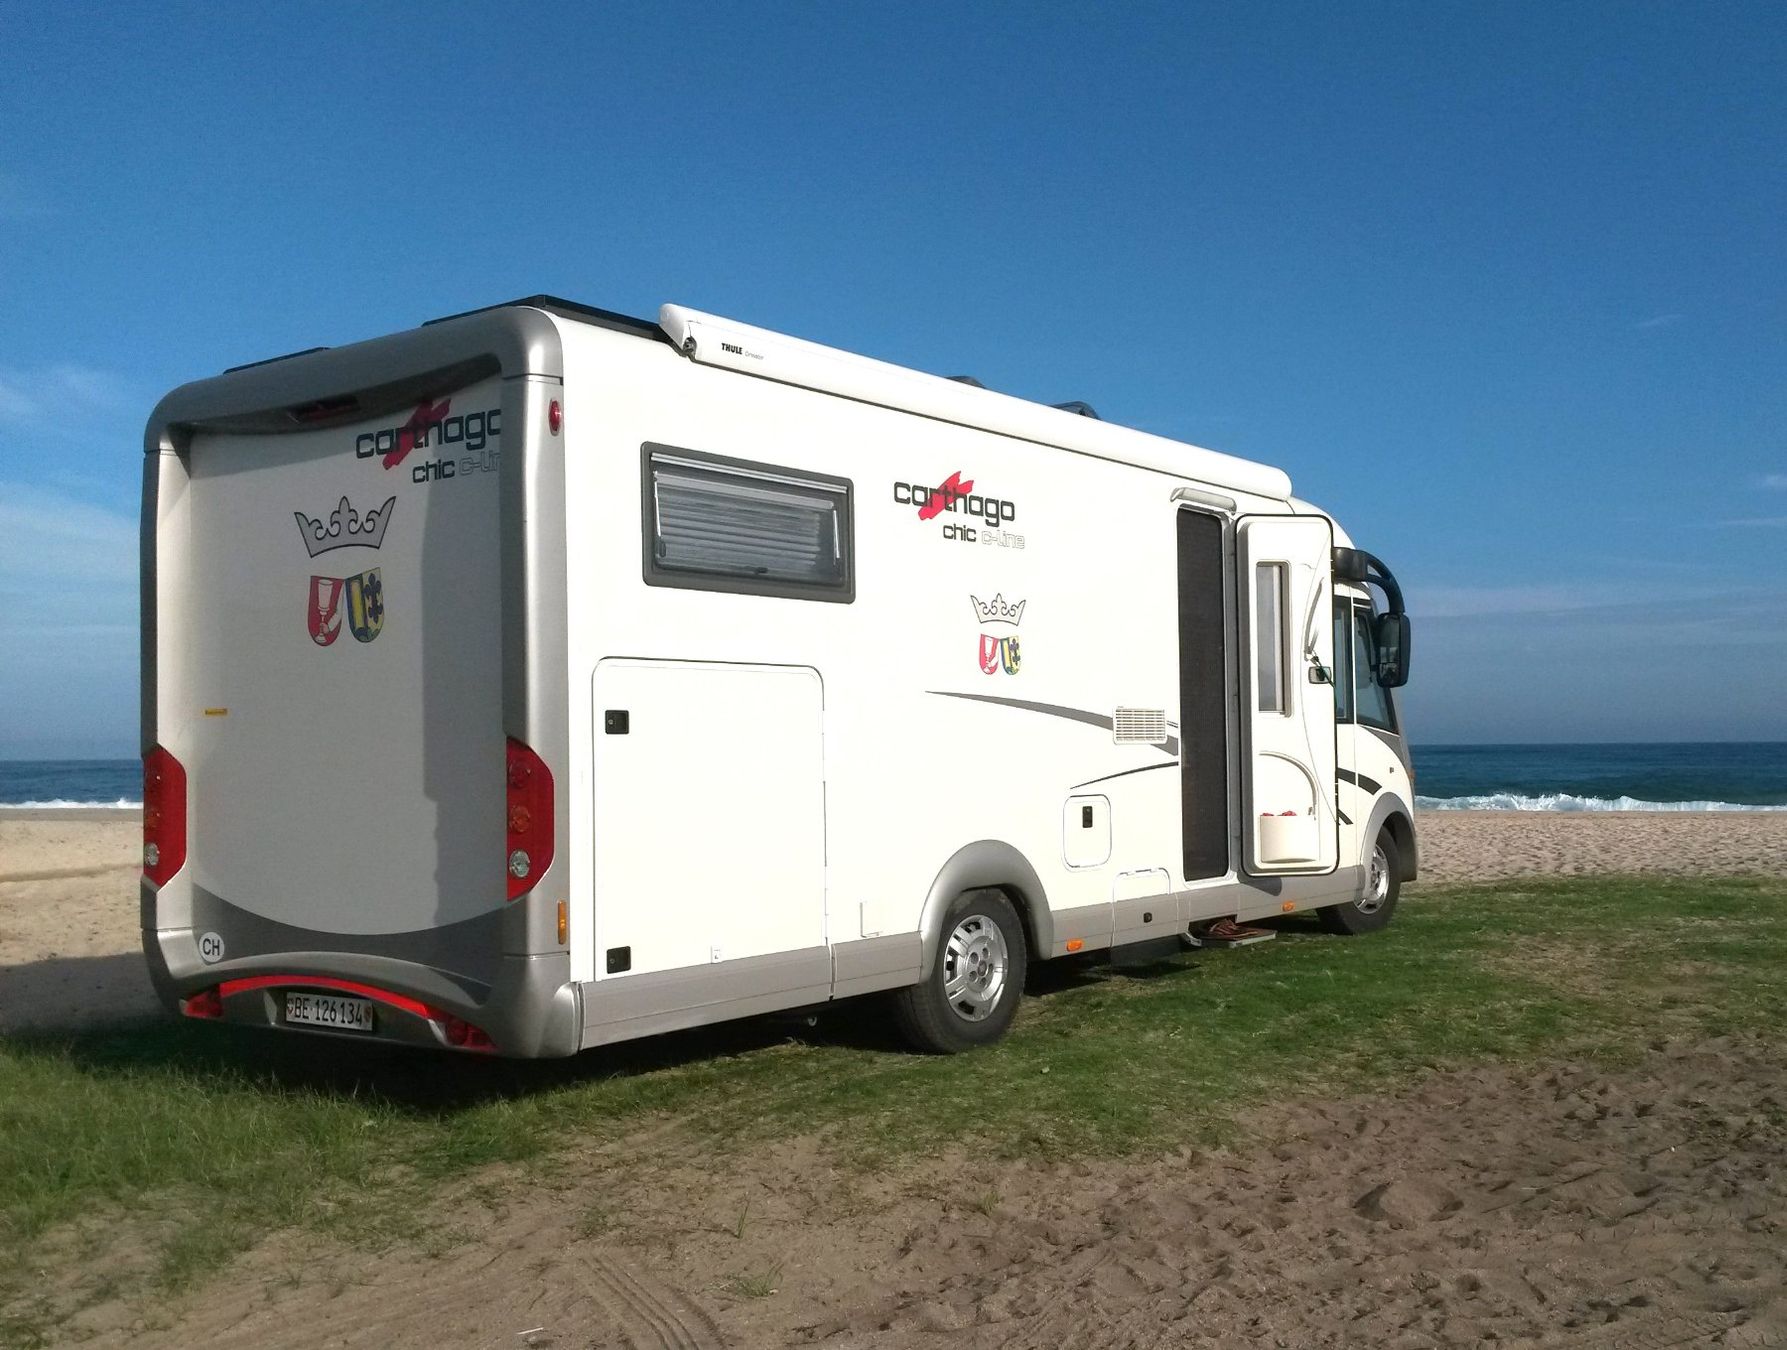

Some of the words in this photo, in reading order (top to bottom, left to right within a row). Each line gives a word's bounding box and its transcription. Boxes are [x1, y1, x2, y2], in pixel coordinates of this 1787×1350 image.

[721, 342, 743, 355] THULE
[412, 459, 455, 483] chic
[893, 481, 1016, 528] carthago
[943, 523, 977, 543] chic
[202, 938, 221, 957] CH
